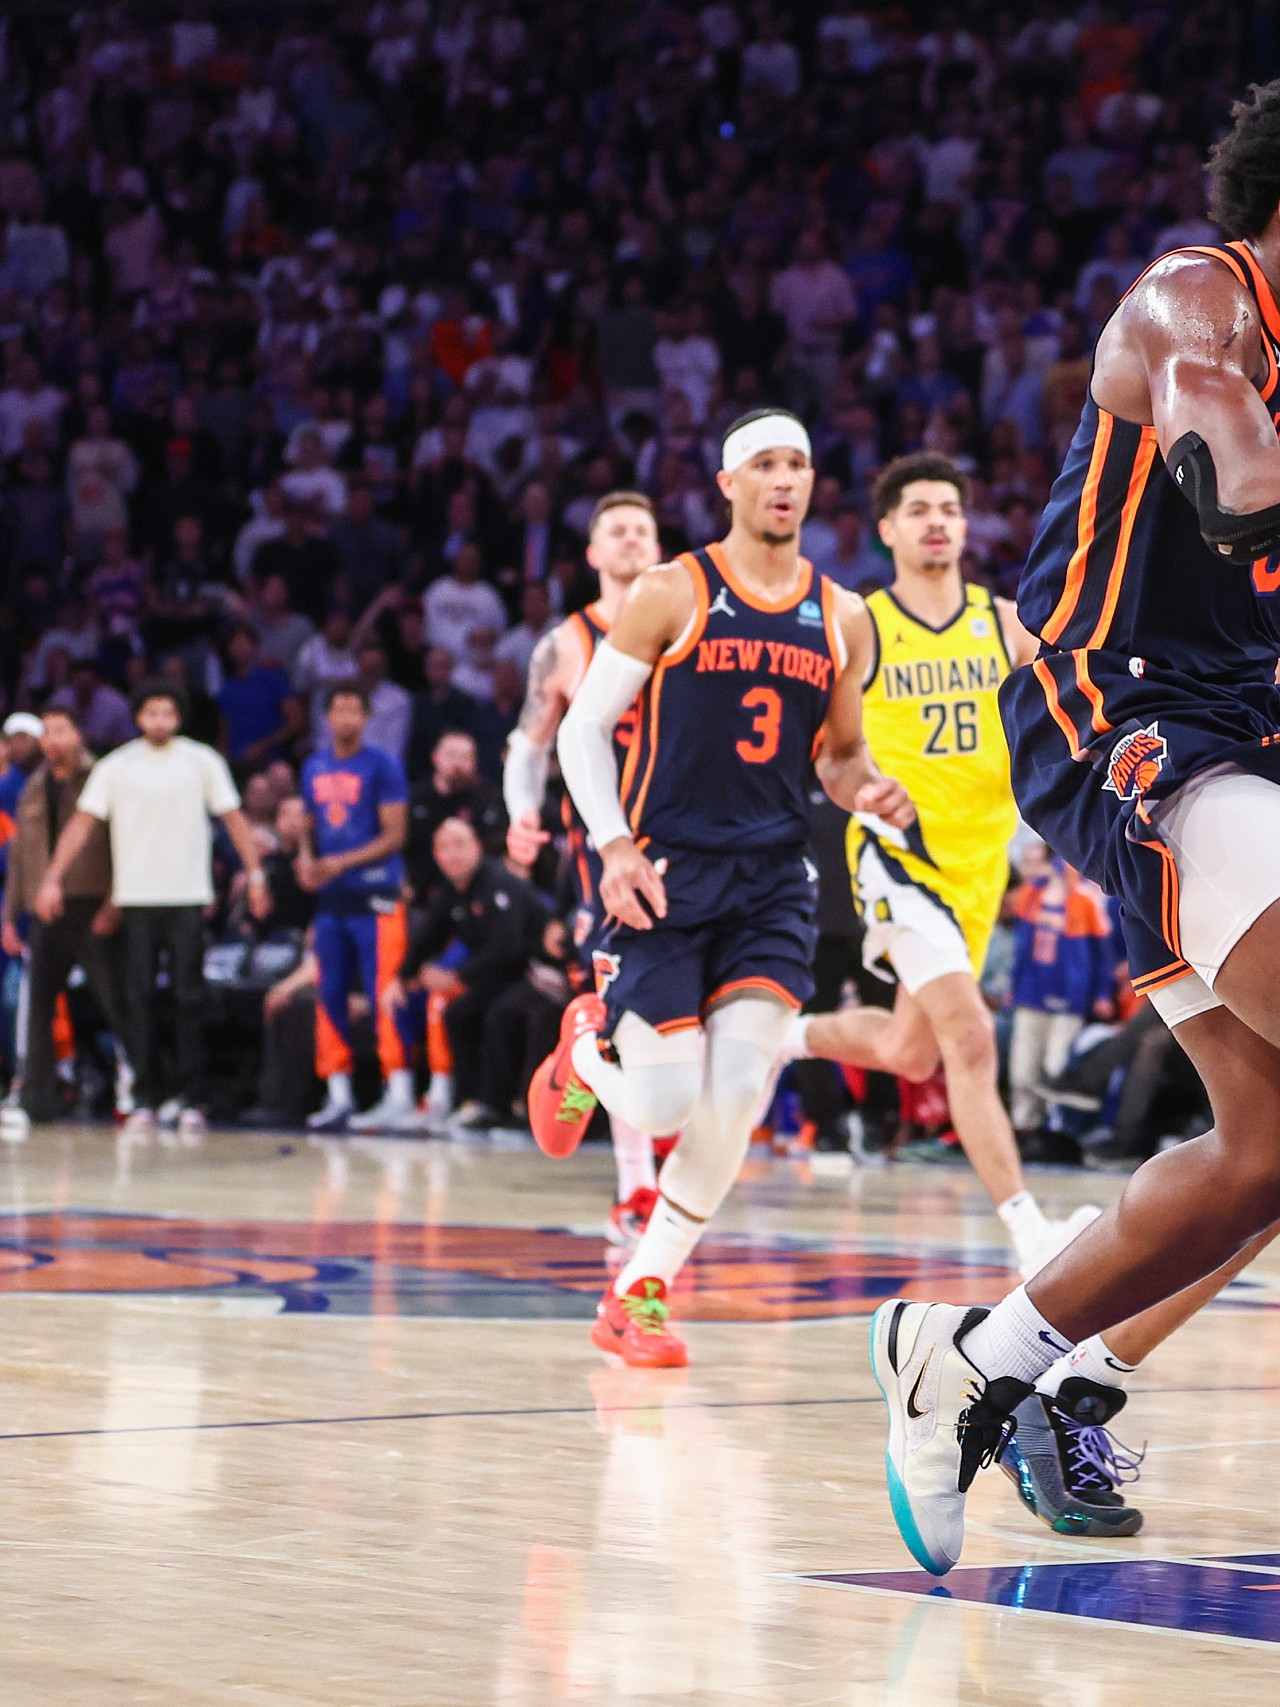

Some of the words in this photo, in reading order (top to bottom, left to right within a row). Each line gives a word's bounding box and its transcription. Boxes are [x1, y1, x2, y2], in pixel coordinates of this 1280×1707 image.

[696, 637, 763, 672] NEW
[766, 641, 832, 690] YORK
[884, 655, 1001, 699] INDIANA
[736, 686, 783, 763] 3
[921, 700, 978, 756] 26
[1111, 733, 1163, 797] KNICKS
